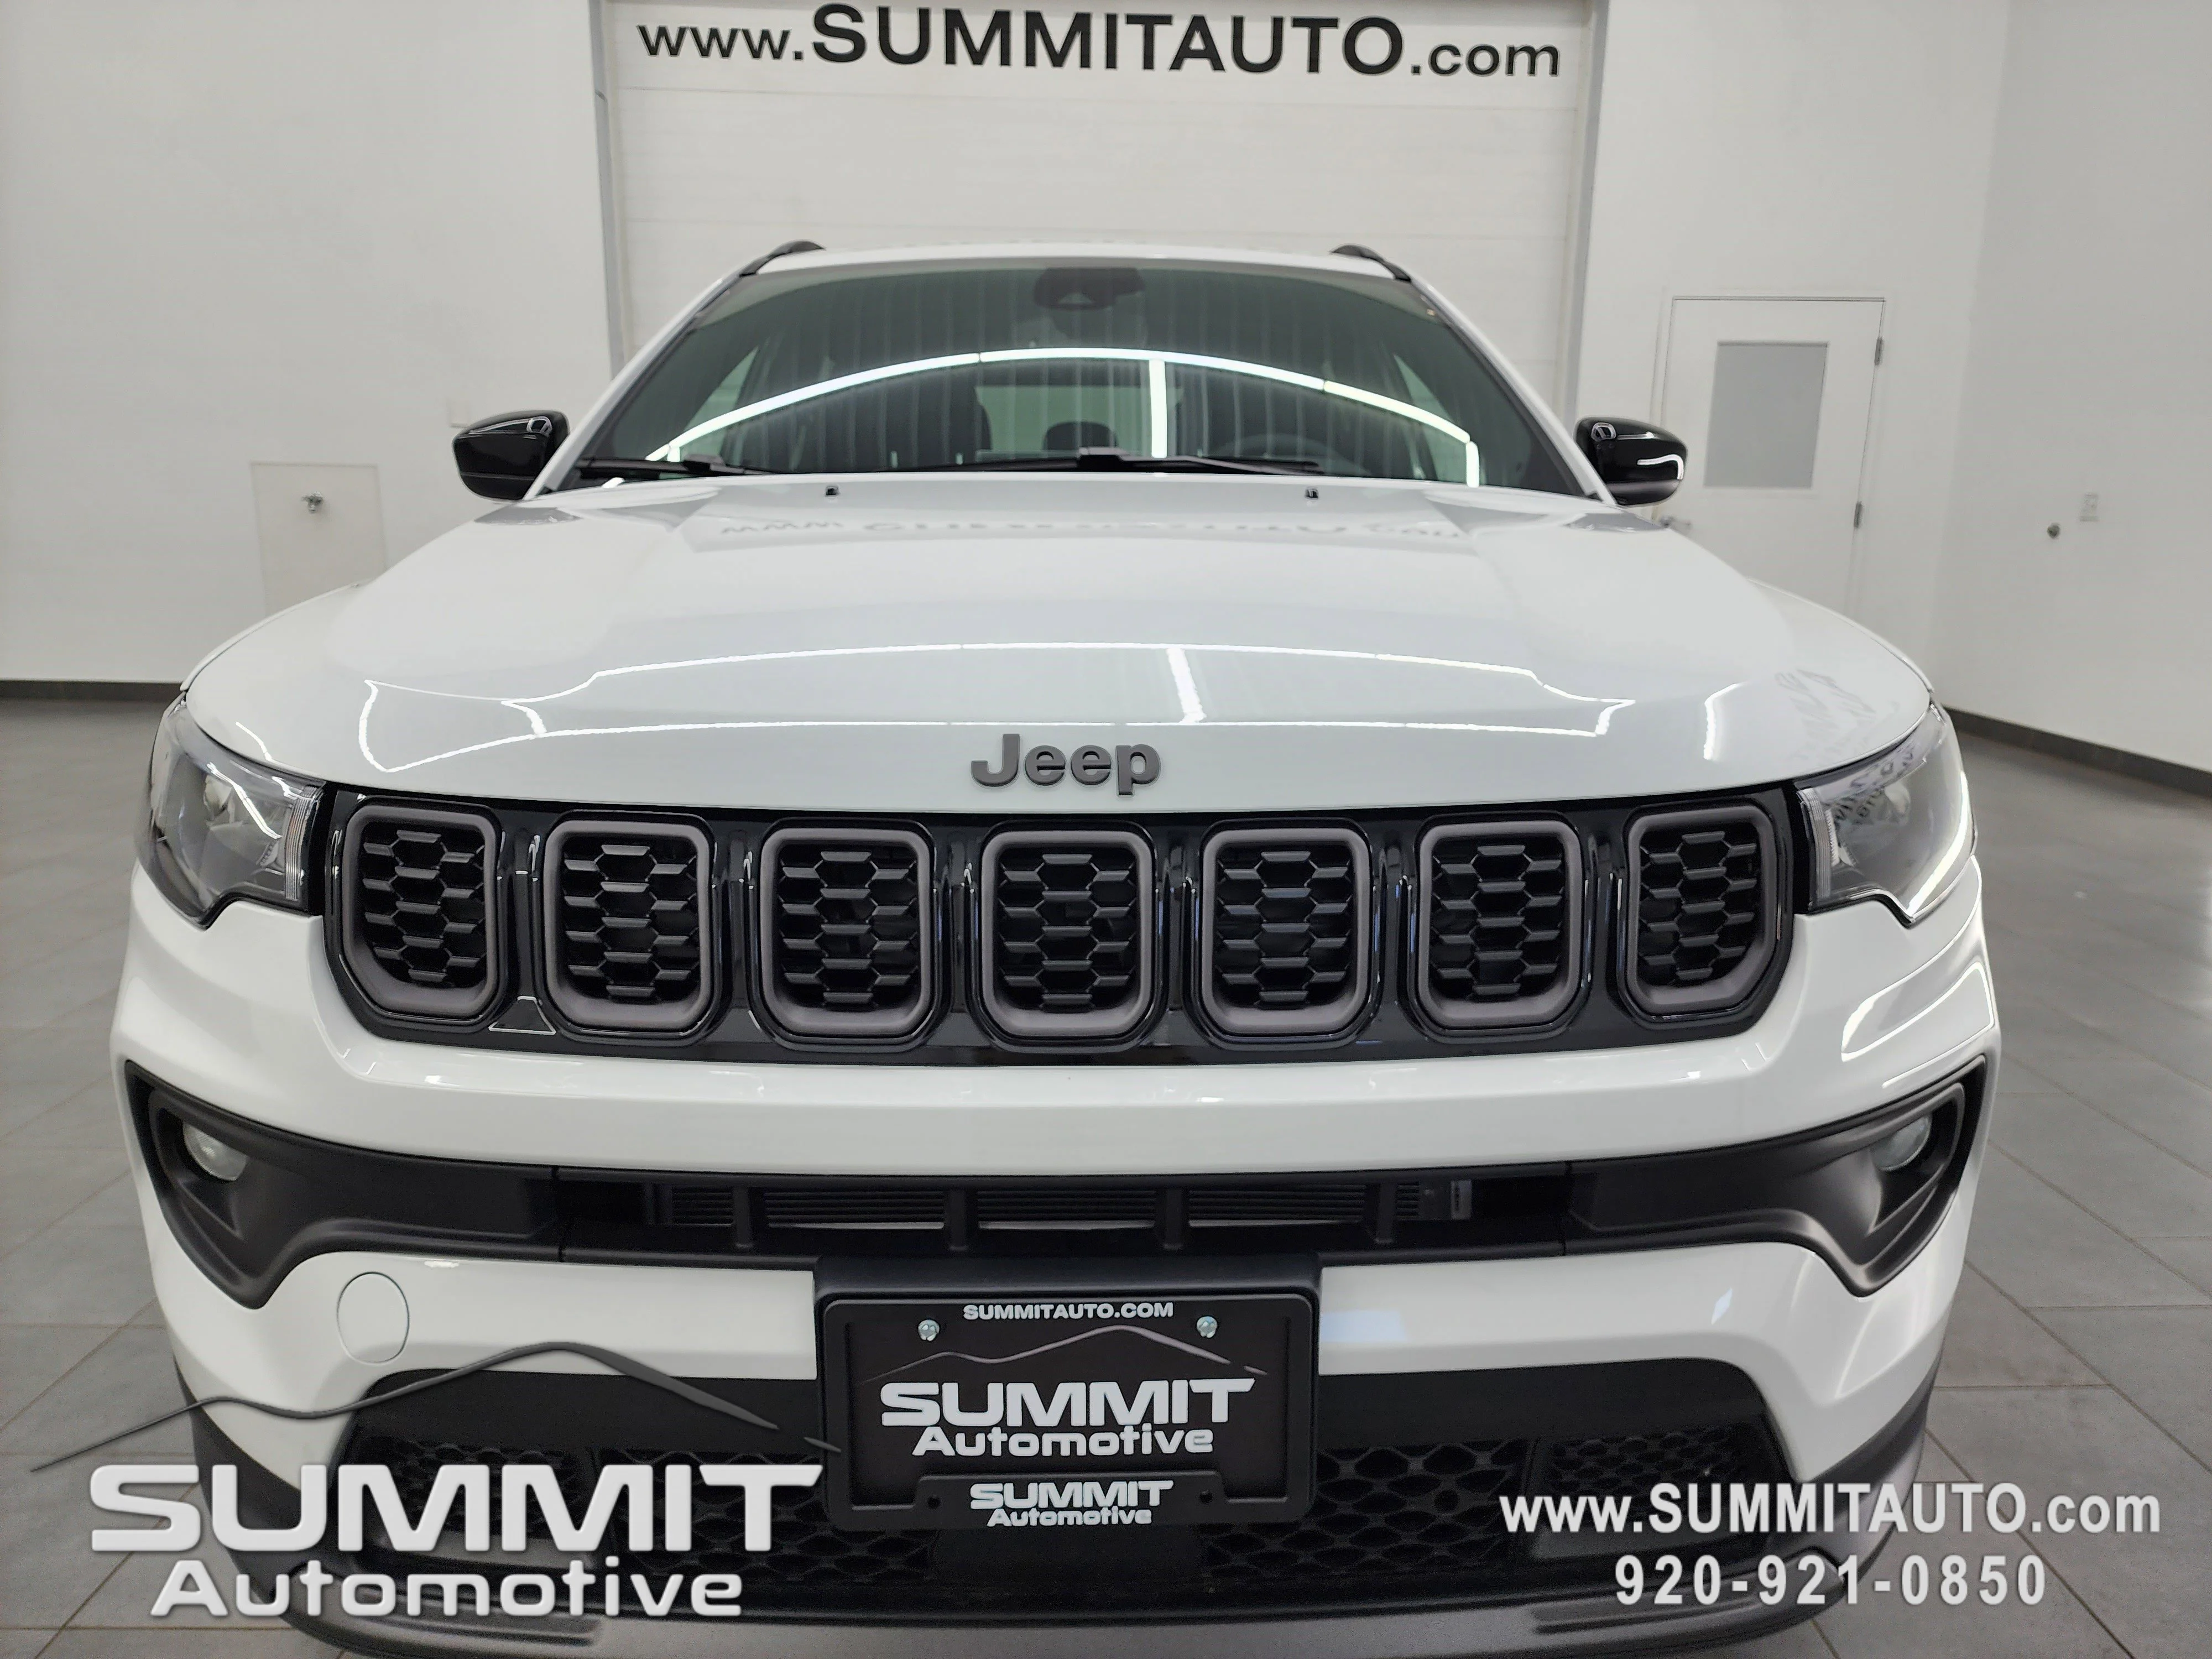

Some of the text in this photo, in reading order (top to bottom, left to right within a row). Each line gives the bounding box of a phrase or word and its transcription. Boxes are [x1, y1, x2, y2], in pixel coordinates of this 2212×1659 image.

[637, 2, 1560, 76] www.SUMMITAUTO.com
[971, 733, 1161, 798] Jeep
[963, 1302, 1173, 1320] SUMMITAUTO.COM
[880, 1378, 1255, 1427] SUMMIT
[912, 1423, 1214, 1457] Automotive
[969, 1480, 1174, 1510] SUMMIT
[987, 1505, 1153, 1527] Automotive
